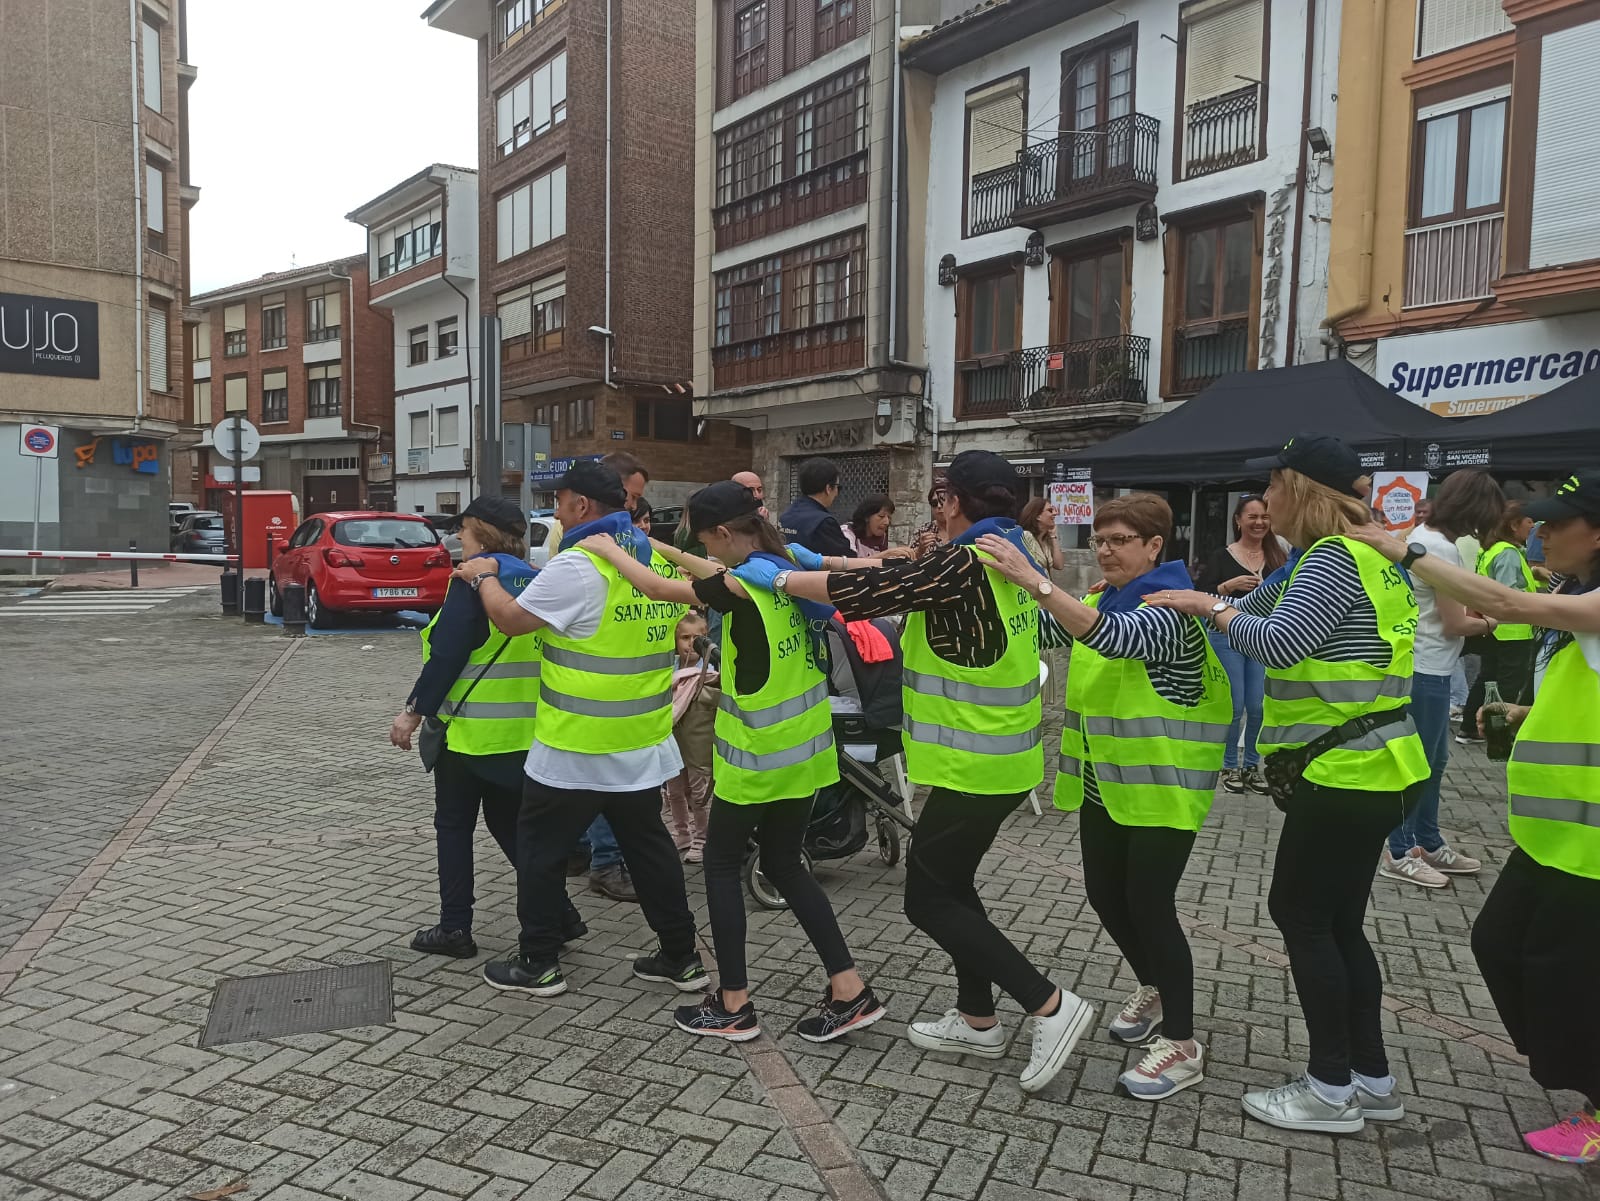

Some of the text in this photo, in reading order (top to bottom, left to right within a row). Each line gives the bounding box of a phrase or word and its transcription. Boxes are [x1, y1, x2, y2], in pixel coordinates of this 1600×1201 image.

[1447, 395, 1536, 416] Supermar
[614, 603, 642, 622] SAN
[646, 624, 668, 642] SVB
[1009, 611, 1028, 636] SAN
